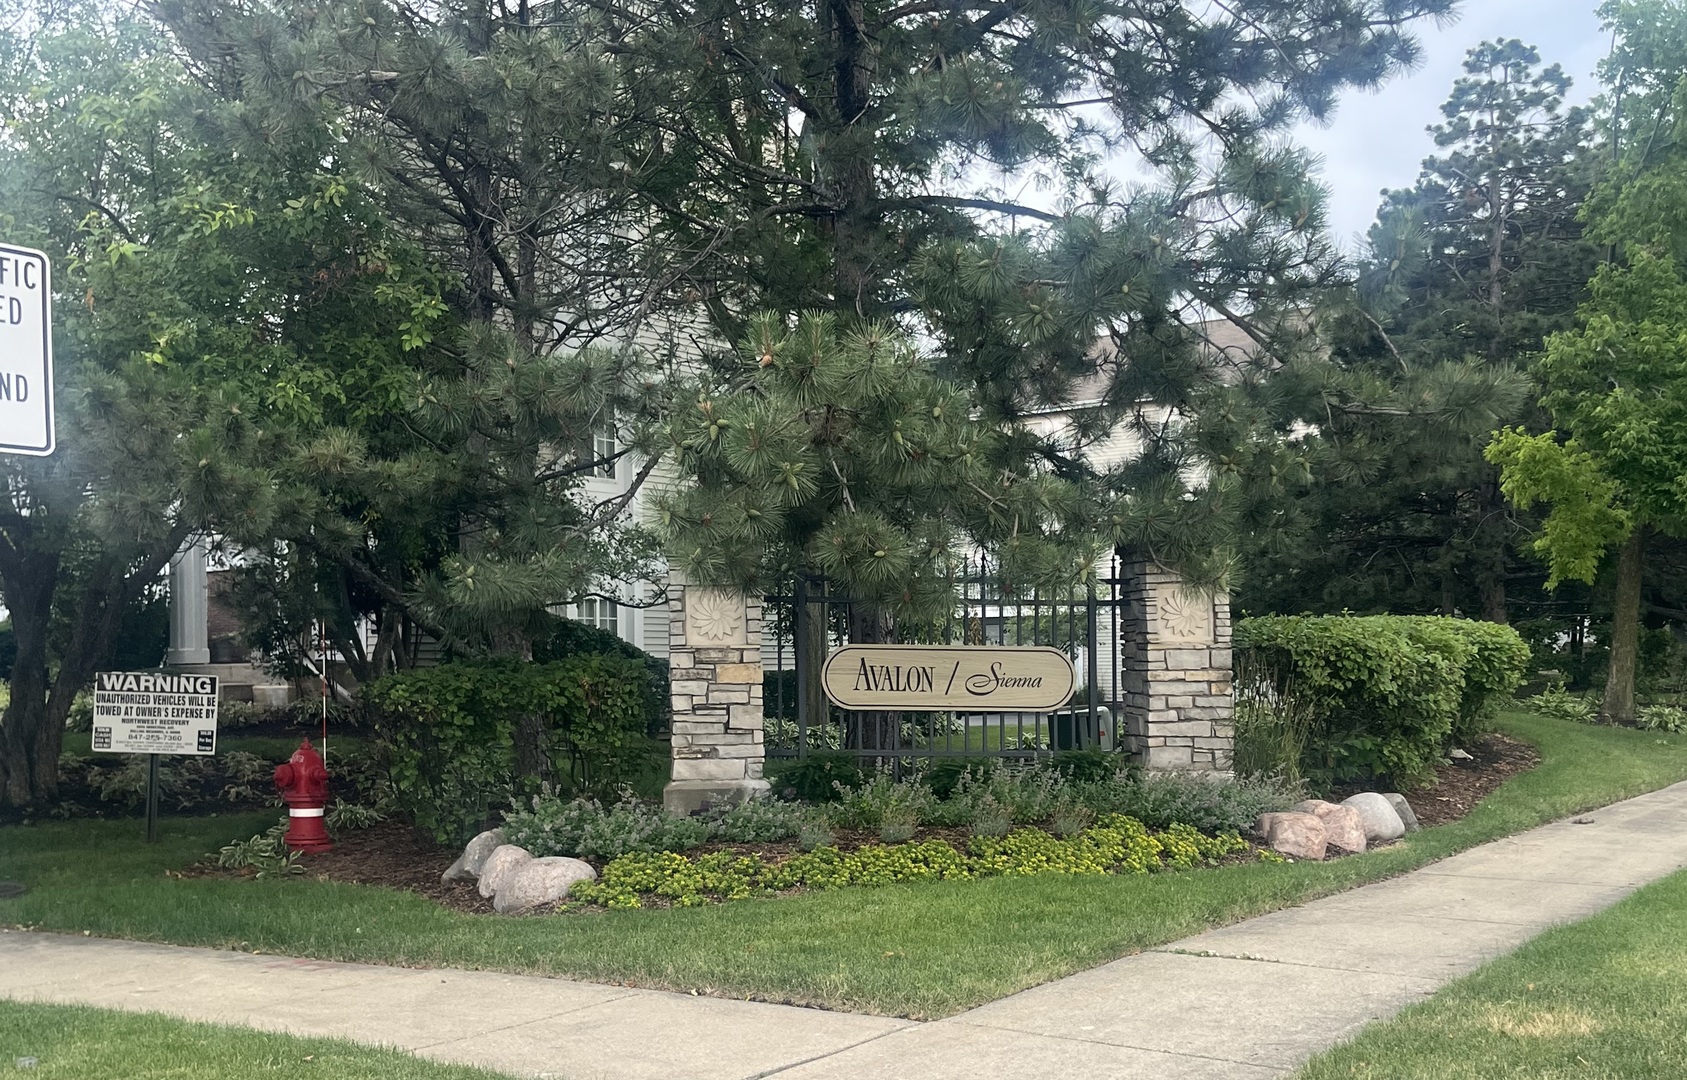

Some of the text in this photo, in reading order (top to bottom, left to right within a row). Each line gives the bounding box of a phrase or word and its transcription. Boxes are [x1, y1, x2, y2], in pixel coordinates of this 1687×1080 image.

[0, 256, 36, 290] FIC
[102, 674, 212, 694] WARNING
[853, 657, 936, 693] AVALON
[965, 662, 1043, 696] Sienna
[96, 693, 216, 707] UNAUTHORIZED VEHICLES WILL BE
[96, 706, 215, 719] TOWED AT OWNER'S EXPENSE BY
